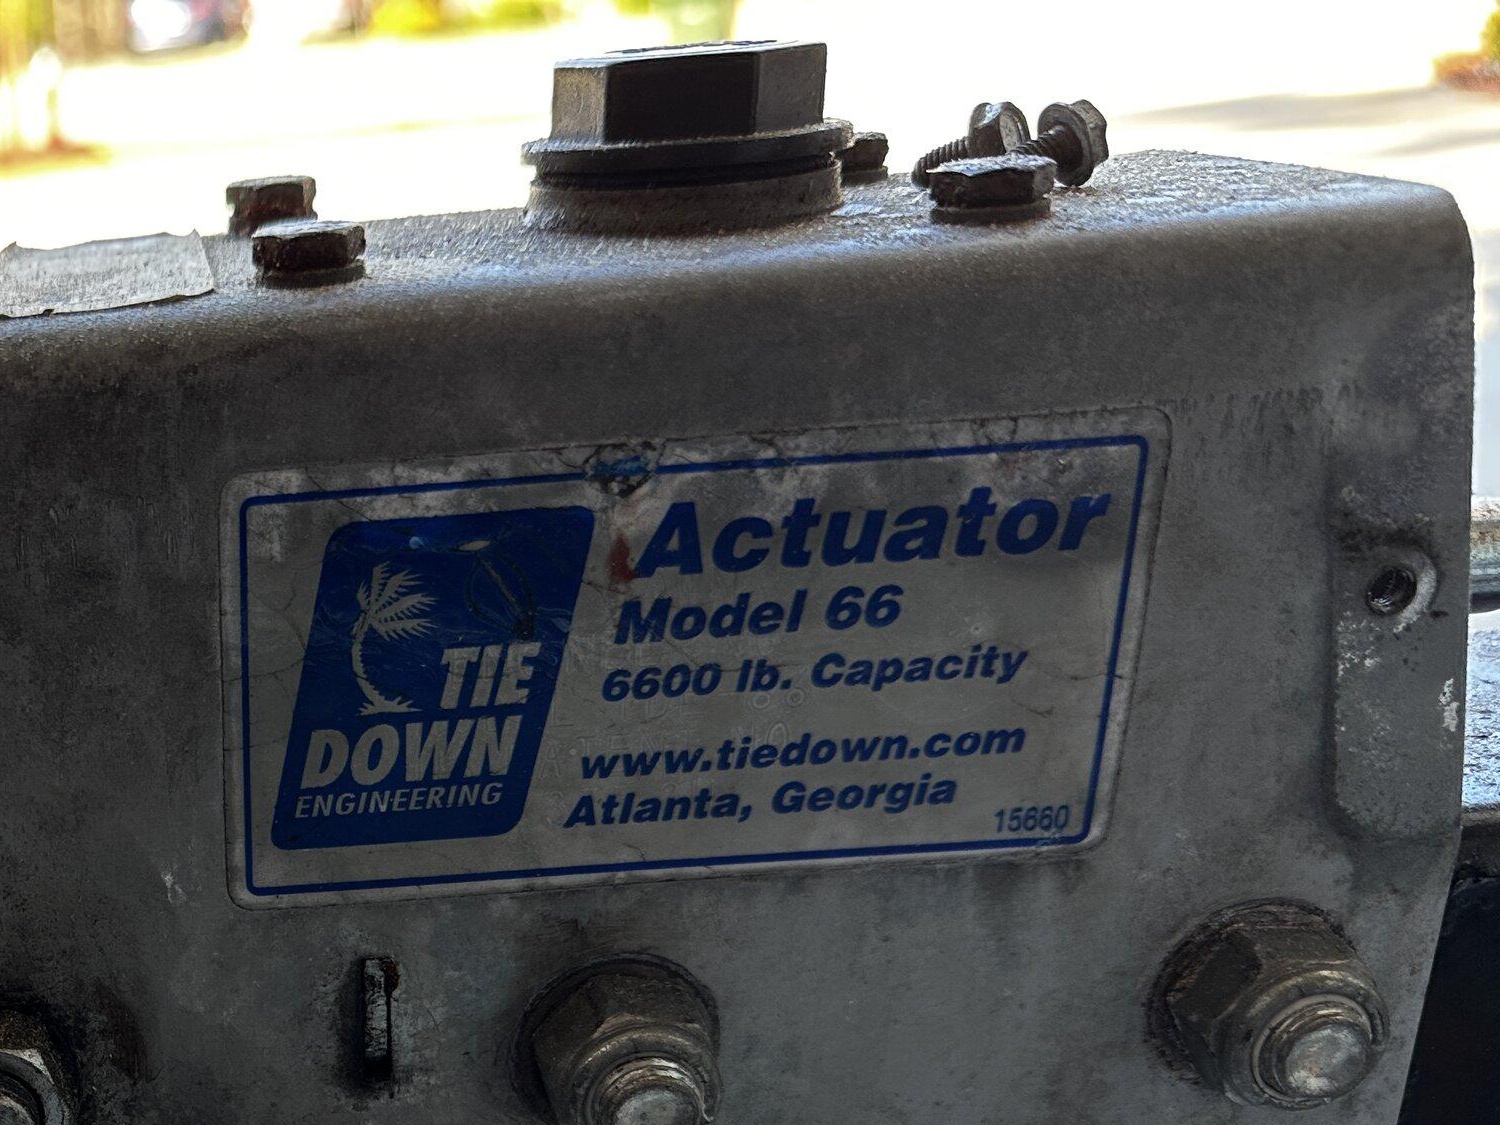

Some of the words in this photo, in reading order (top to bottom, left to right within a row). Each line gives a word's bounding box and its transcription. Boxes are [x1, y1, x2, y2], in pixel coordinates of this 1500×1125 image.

[632, 485, 1113, 578] Actuator
[614, 588, 808, 646] Model
[825, 584, 905, 630] 66
[439, 641, 541, 710] TIE
[601, 662, 722, 702] 6600
[735, 658, 792, 693] lb.
[811, 643, 1029, 692] Capacity
[300, 714, 524, 790] DOWN
[581, 727, 1026, 780] www.tiedown.com
[294, 782, 503, 819] ENGINEERING
[564, 788, 752, 829] Atlanta,
[771, 772, 958, 814] Georgia
[994, 804, 1070, 833] 15660
